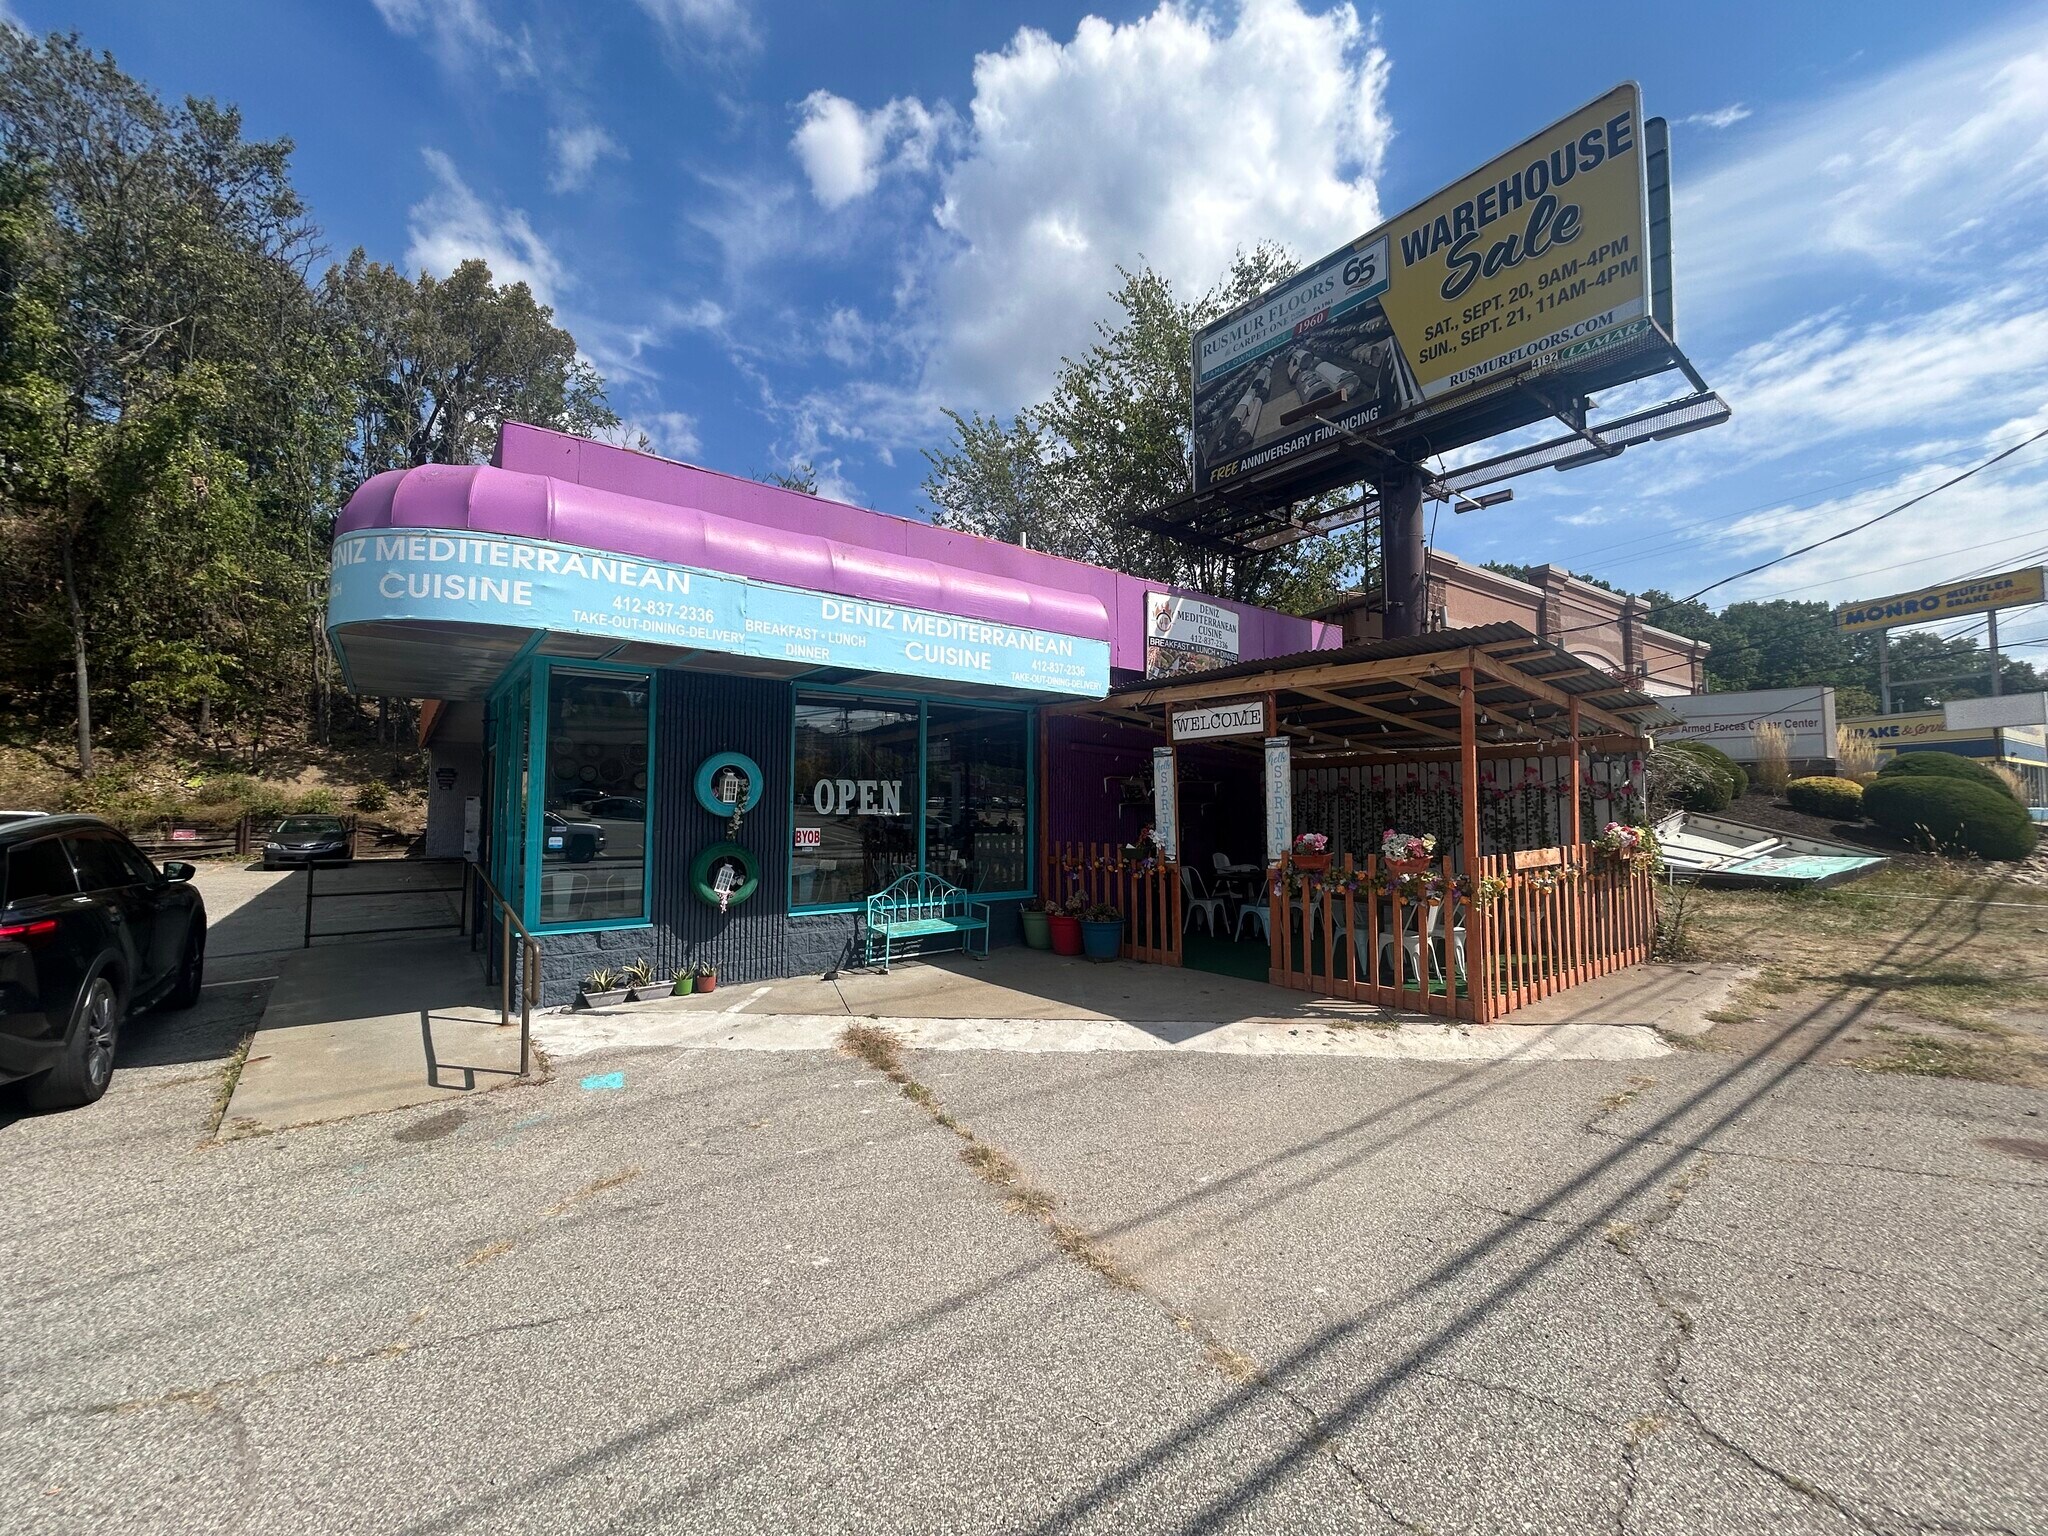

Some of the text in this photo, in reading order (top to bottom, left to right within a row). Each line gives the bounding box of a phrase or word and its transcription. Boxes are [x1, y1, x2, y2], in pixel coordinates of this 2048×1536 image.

[1400, 110, 1634, 268] WAREHOUSE
[1440, 194, 1583, 301] Sale
[1424, 235, 1629, 341] SAT., SEPT. 20, 9AM-4PM
[1202, 276, 1335, 359] RUSMUR FLOORS
[1298, 313, 1324, 334] 1960
[1419, 255, 1639, 364] SUN., SEPT. 21, 11AM-4PM
[1232, 330, 1267, 352] CARPET
[1269, 317, 1288, 333] ONE
[1450, 311, 1614, 386] RUSMURFLOORS.COM
[1568, 324, 1639, 357] LAMAR
[1205, 364, 1231, 378] FAMILY
[1233, 347, 1261, 365] OWNED
[1263, 333, 1288, 350] SINCE
[1532, 352, 1558, 369] 4192
[1210, 460, 1239, 483] FREE
[1240, 433, 1312, 472] ANNIVERSARY
[332, 536, 691, 595] ENIZ MEDITERRANEAN
[379, 571, 533, 606] CUISINE
[1846, 595, 1940, 625] MONRO
[1946, 579, 2014, 599] MUFFLER
[1946, 593, 1990, 608] BRAKE
[612, 595, 715, 624] 412-837-2336
[1177, 610, 1237, 634] MEDITERRANEAN
[1200, 604, 1219, 618] DENIZ
[572, 609, 746, 644] TAKE-OUT-DINING-DELIVERY
[745, 619, 867, 648] BREAKFAST LUNCH
[821, 599, 1073, 657] DENIZ MEDITERRANEAN
[1198, 625, 1222, 640] CUSINE
[785, 643, 830, 660] DINNER
[905, 641, 991, 670] CUISINE
[1150, 637, 1238, 661] BREAKFAST LUNCH DINNER
[1190, 634, 1228, 650] 412-837-2336
[1011, 671, 1103, 691] TAKE-OUT-DINING-DELIVERY
[1031, 659, 1085, 677] 412-837-2336
[1174, 710, 1261, 733] WELCOME
[1681, 723, 1711, 733] Armed
[1714, 722, 1746, 732] Forces
[1785, 719, 1818, 729] Center
[1847, 725, 1900, 739] RAKE
[814, 779, 902, 815] OPEN
[796, 830, 820, 843] BYOB
